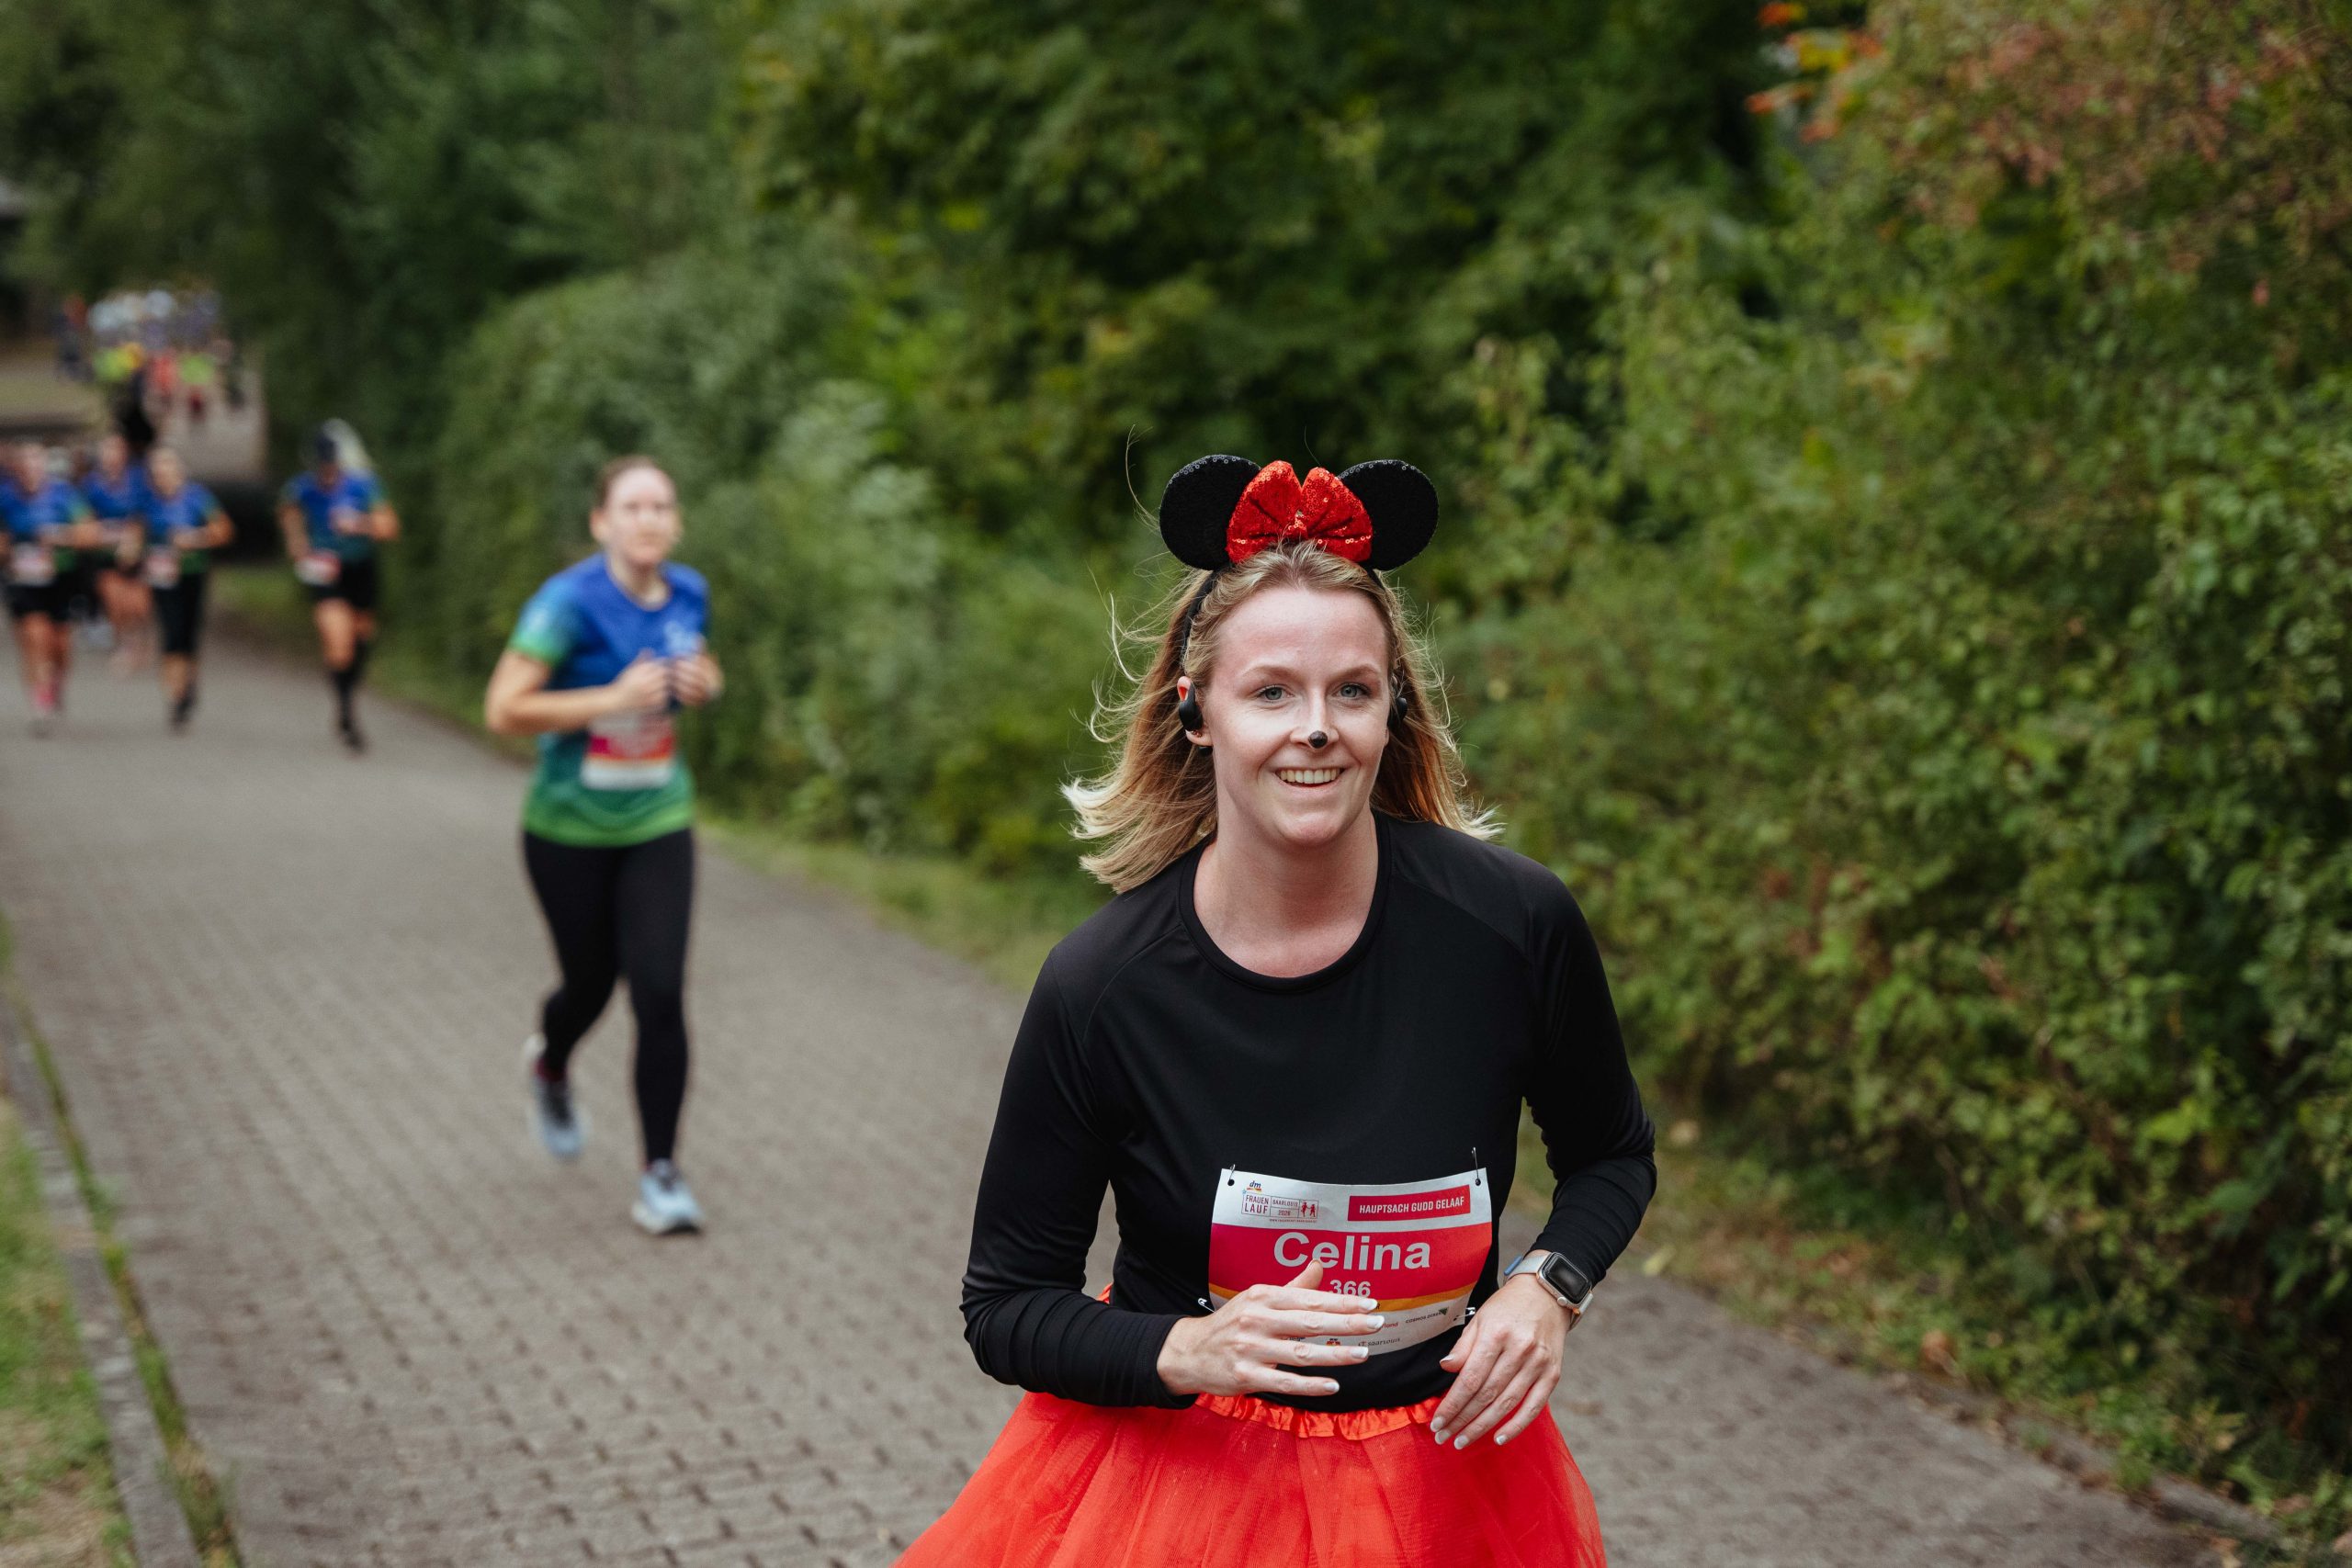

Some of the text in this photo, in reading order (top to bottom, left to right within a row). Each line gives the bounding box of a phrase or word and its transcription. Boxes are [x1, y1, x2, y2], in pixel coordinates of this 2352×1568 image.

[1244, 1202, 1269, 1214] LAUF
[1245, 1194, 1269, 1205] FRAUEN
[1359, 1196, 1464, 1213] HAUPTSACH GUDD GELAAF
[1273, 1232, 1430, 1270] Celina
[1329, 1280, 1371, 1298] 366
